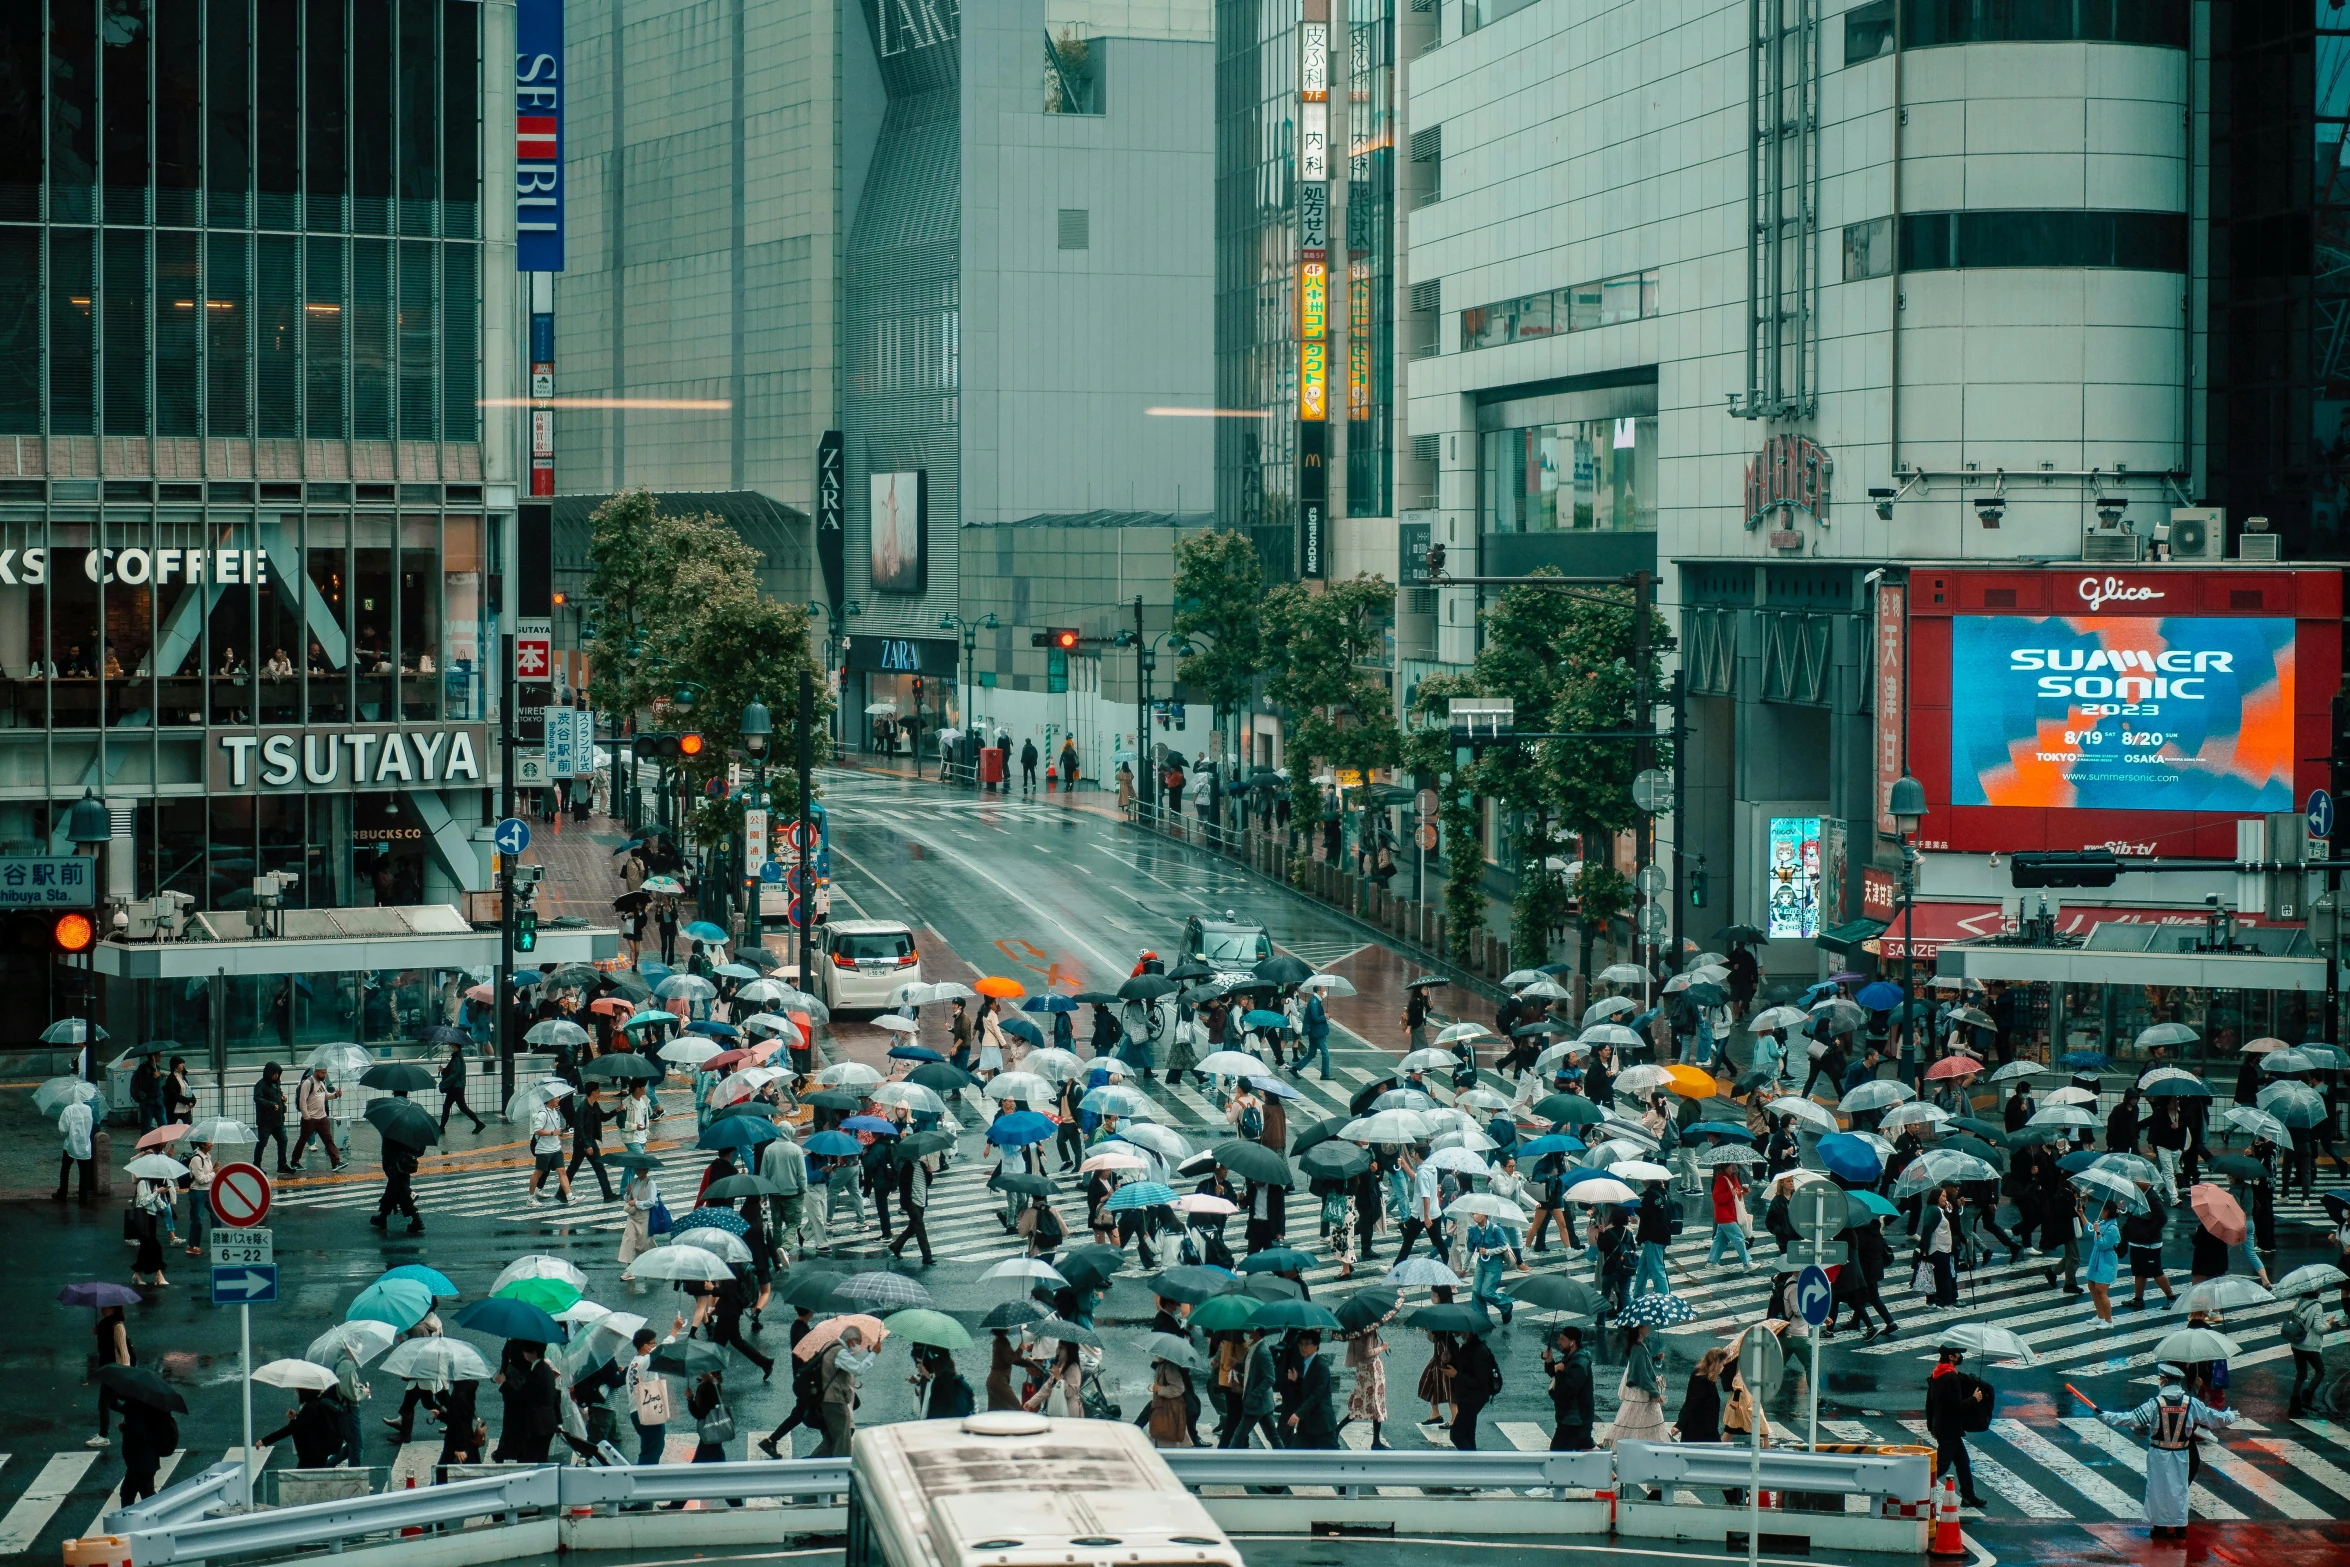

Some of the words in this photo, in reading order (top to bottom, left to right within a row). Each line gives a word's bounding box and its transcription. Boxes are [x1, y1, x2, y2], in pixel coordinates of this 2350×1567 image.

[1304, 26, 1324, 88] 皮ふ科
[1307, 92, 1321, 101] 7F
[517, 53, 557, 231] SEIBU
[1306, 131, 1323, 175] 内科
[1304, 187, 1324, 246] 処方せん
[1307, 266, 1320, 274] 4F
[821, 448, 840, 530] ZARA
[1744, 434, 1828, 527] MAGNET
[1308, 507, 1317, 572] McDonald's
[85, 548, 267, 584] COFFEE
[1882, 593, 1900, 617] 名物
[2079, 576, 2165, 611] Glico
[518, 644, 545, 673] 本
[881, 639, 919, 671] ZARA
[2010, 648, 2234, 673] SUMMER
[2037, 676, 2205, 700] SONIC
[2081, 703, 2160, 716] 2023
[557, 712, 570, 772] 渋谷駅前
[579, 714, 590, 771] スクランブル式
[2064, 731, 2103, 745] 8/19
[2121, 732, 2163, 746] 8/20
[222, 731, 480, 787] TSUTAYA
[2036, 753, 2077, 762] TOKYO
[2124, 754, 2165, 764] OSAKA
[2062, 773, 2179, 783] www.summersonic.com
[4, 863, 83, 886] 谷駅前
[46, 889, 72, 901] Sta.
[1865, 880, 1893, 908] 天津甘栗
[1887, 943, 1938, 957] SANZE
[213, 1232, 268, 1245] 路線バスを除く
[221, 1249, 262, 1262] 6-22
